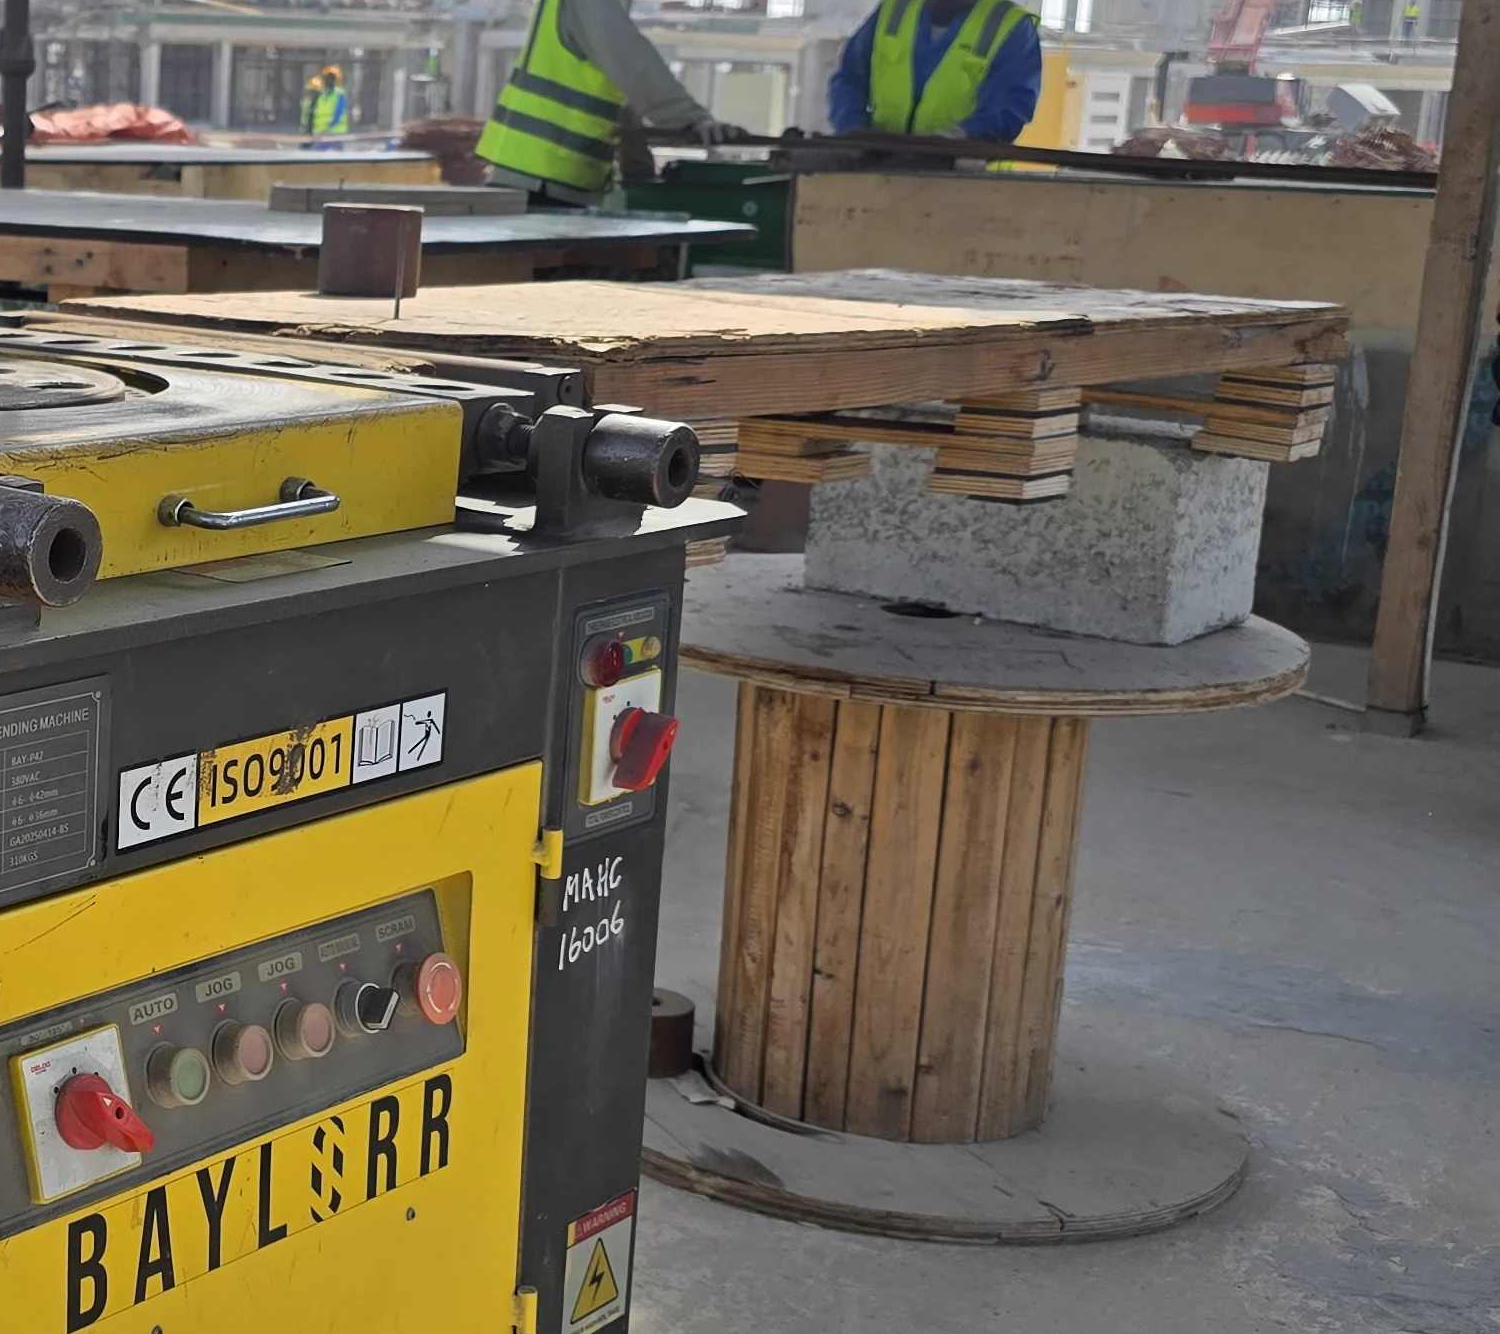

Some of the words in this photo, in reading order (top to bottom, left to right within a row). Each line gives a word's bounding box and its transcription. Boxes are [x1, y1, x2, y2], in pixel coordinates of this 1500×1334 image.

[39, 707, 90, 731] MACHINE
[11, 771, 41, 787] 380VAC
[130, 767, 187, 831] CE
[211, 732, 343, 809] ISO9001
[377, 919, 414, 939] SCRAM
[558, 899, 625, 971] 16006
[267, 960, 295, 977] JOG
[204, 980, 233, 997] JOG
[133, 997, 174, 1021] AUTO
[583, 1201, 627, 1233] WARNING
